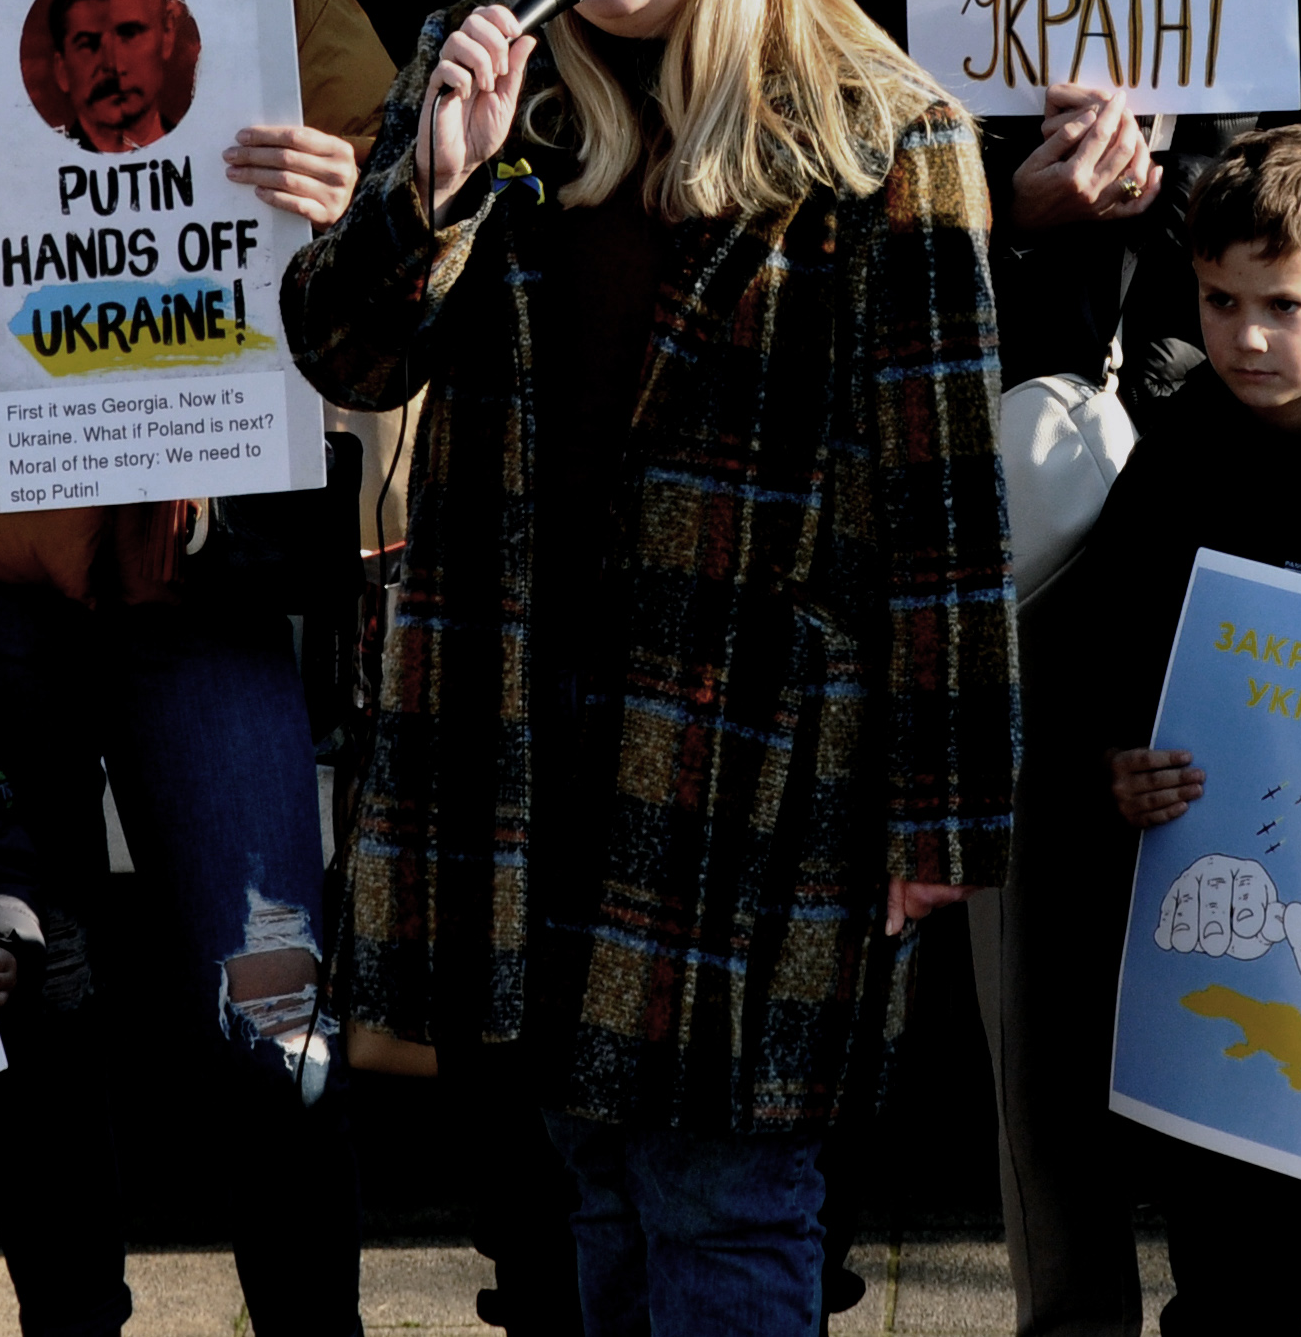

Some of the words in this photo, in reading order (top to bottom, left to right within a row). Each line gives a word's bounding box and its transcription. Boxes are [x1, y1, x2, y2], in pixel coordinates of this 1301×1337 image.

[1, 227, 159, 287] HANDS
[178, 219, 258, 270] OFF
[6, 404, 43, 421] First
[48, 403, 59, 418] it
[63, 403, 97, 416] was
[101, 395, 174, 415] Georgia.
[179, 391, 217, 408] Now
[221, 388, 244, 405] it's
[7, 429, 78, 448] Ukraine.
[83, 425, 127, 443] What
[132, 423, 143, 439] if
[147, 418, 205, 438] Poland
[210, 417, 224, 433] is
[228, 413, 275, 432] next?
[9, 457, 56, 475] Moral
[61, 455, 78, 471] of
[82, 453, 109, 470] the
[114, 450, 160, 469] story:
[166, 447, 193, 464] We
[199, 443, 241, 462] need
[245, 443, 262, 458] to
[10, 487, 47, 505] stop
[51, 481, 99, 500] Putin!
